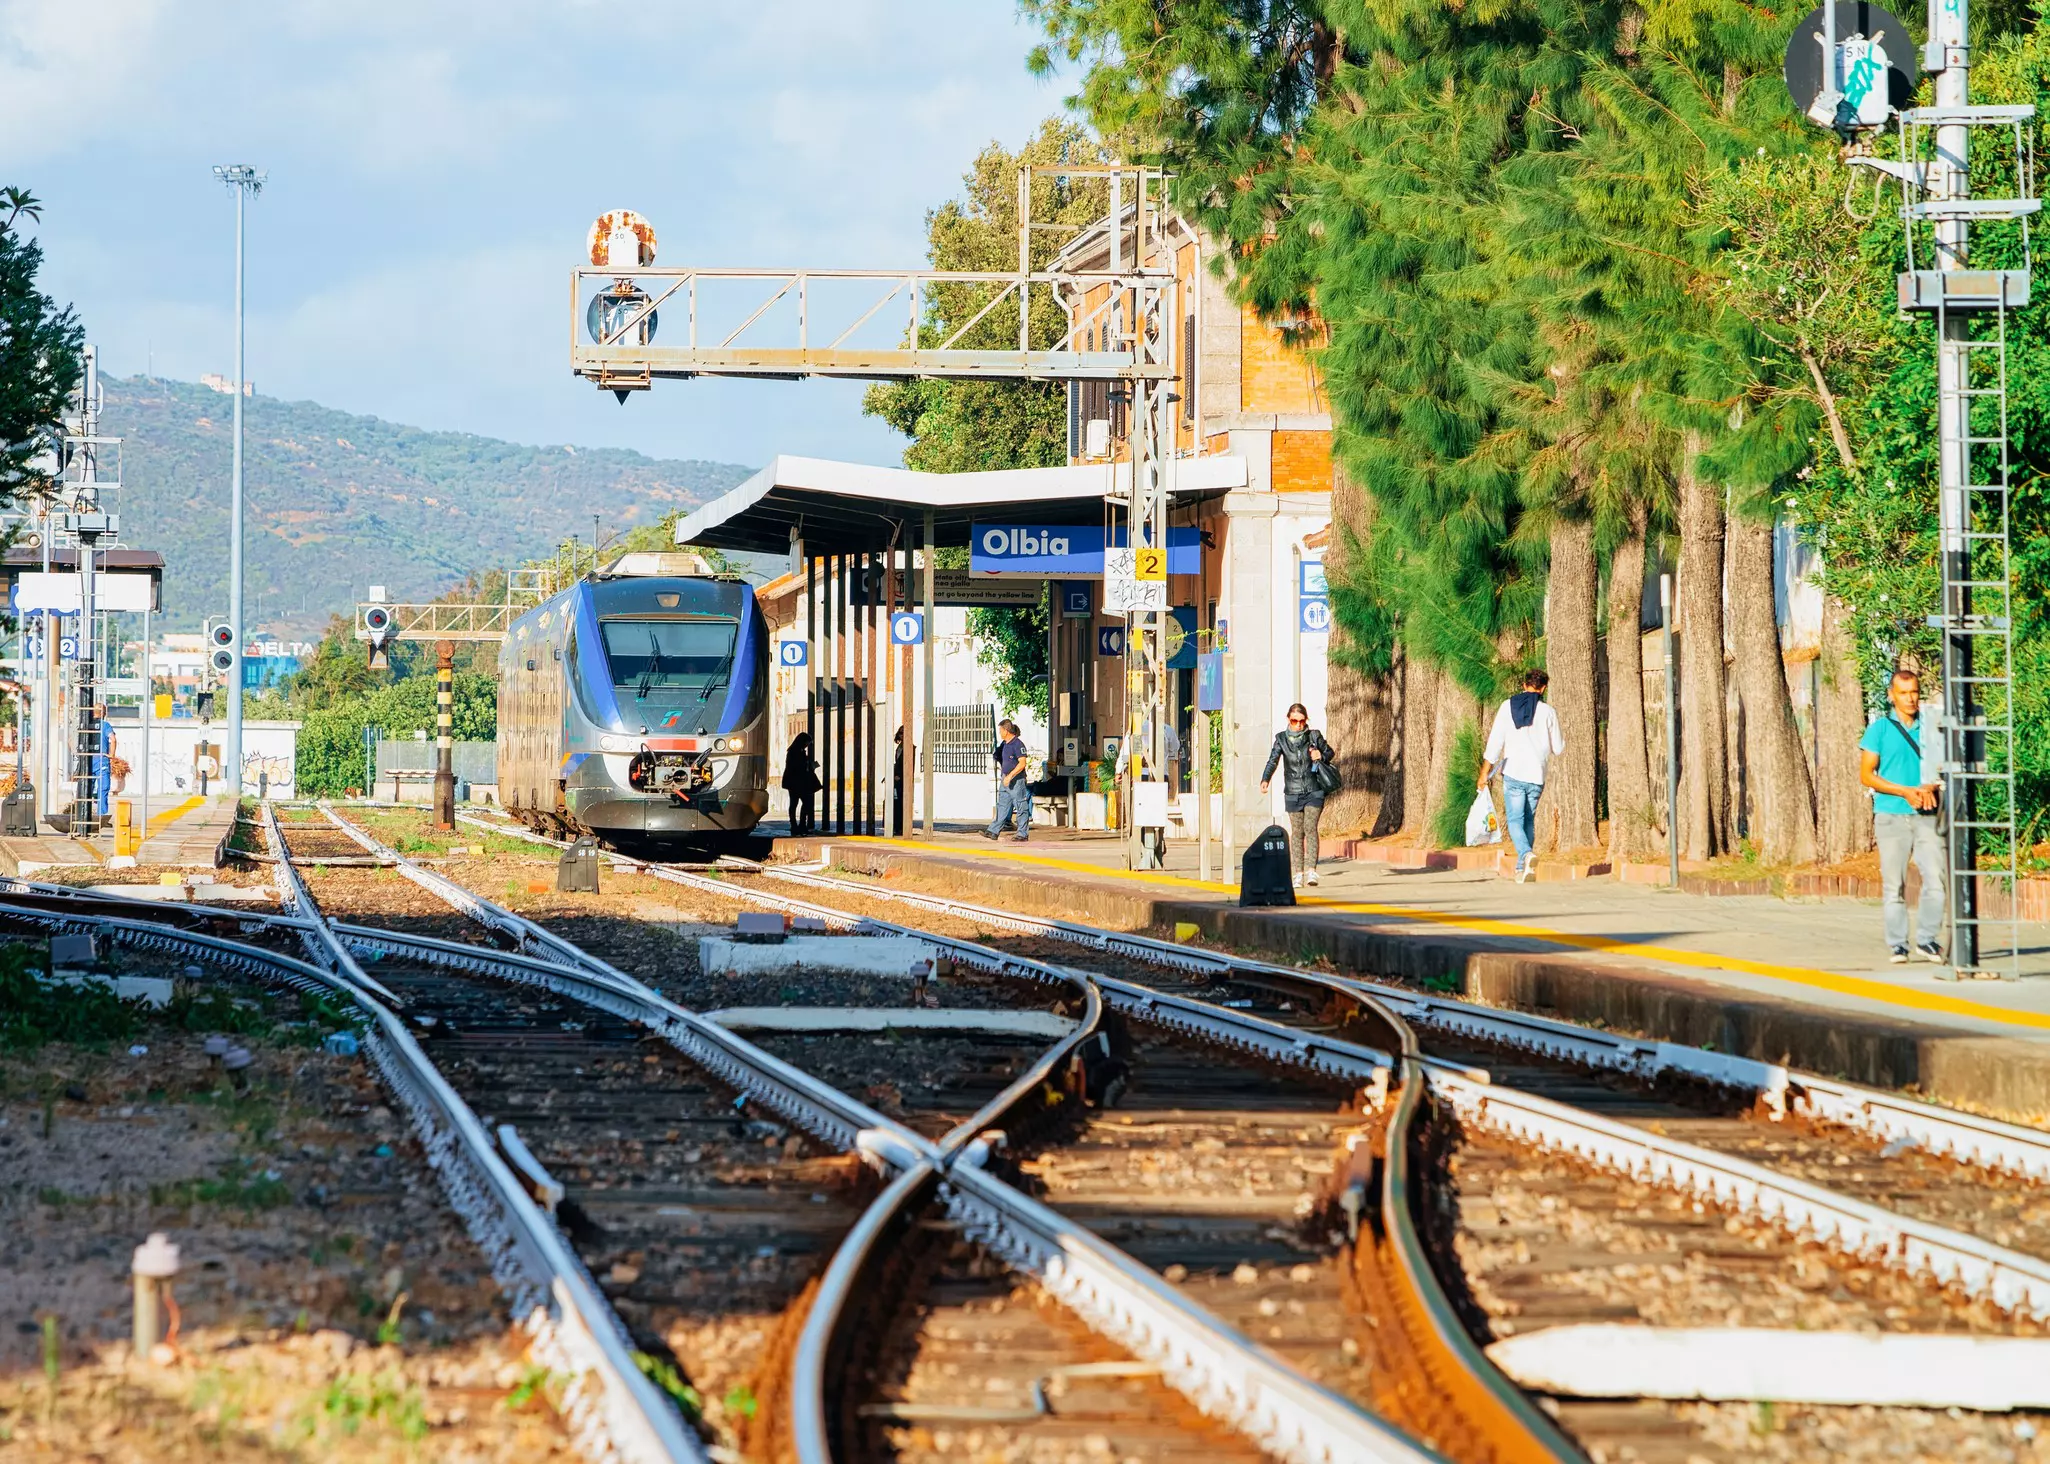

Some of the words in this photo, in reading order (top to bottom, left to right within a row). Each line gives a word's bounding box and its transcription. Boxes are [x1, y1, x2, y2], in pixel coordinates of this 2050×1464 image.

[982, 528, 1069, 556] Olbia
[1145, 556, 1158, 573] 2
[903, 621, 910, 637] 1
[63, 642, 71, 653] 2
[242, 641, 313, 657] DELTA
[1173, 642, 1178, 650] 4
[790, 647, 796, 660] 1
[1264, 842, 1273, 850] SB
